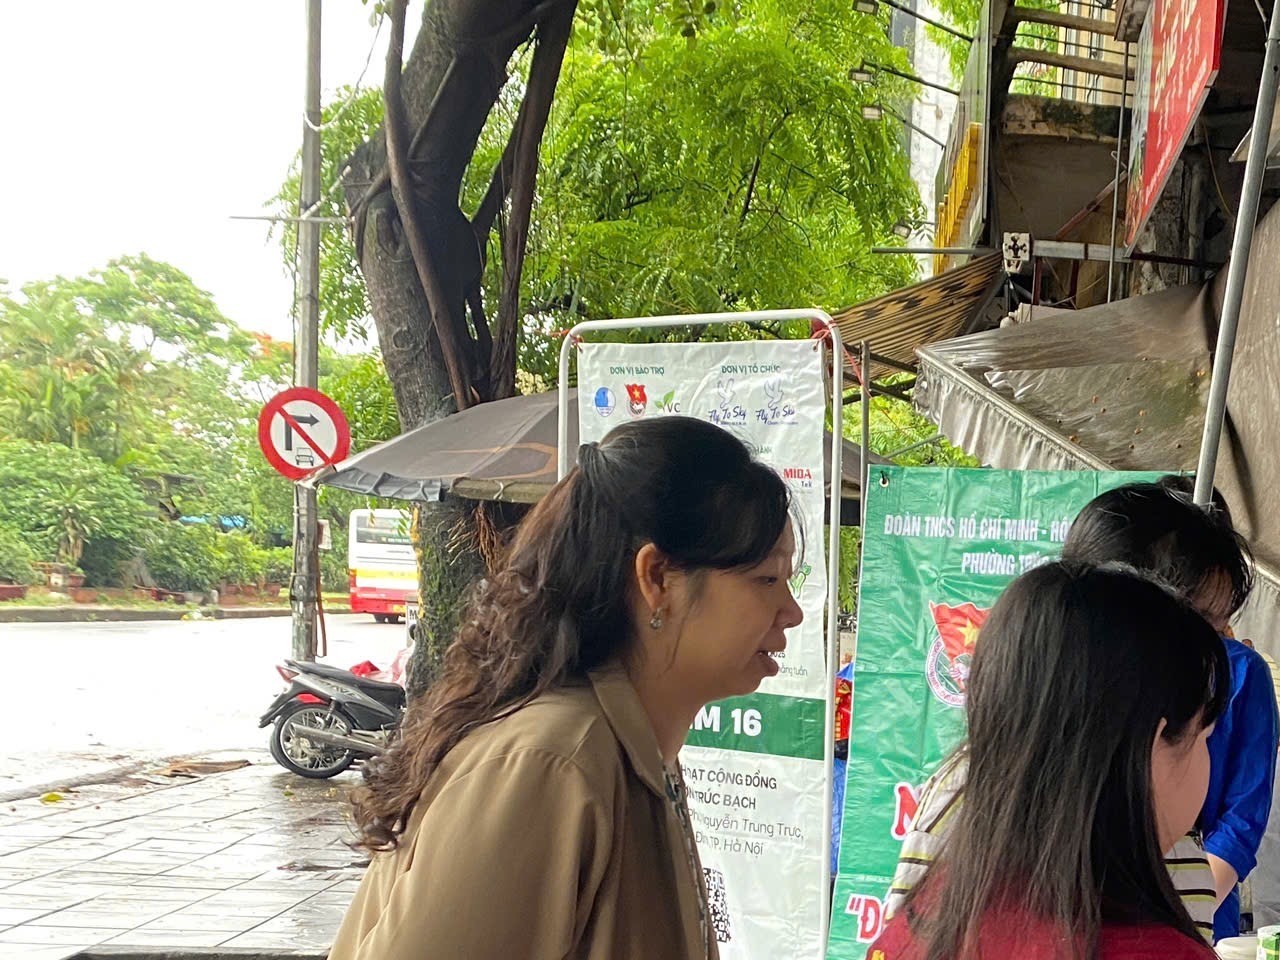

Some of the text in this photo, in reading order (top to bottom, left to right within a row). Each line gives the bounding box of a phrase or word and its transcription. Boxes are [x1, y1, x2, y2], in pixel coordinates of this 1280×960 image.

[783, 468, 812, 479] MIDA
[884, 512, 921, 537] ĐOÀN
[924, 516, 955, 538] TNCS
[979, 515, 1001, 540] CHÍ
[1004, 518, 1038, 542] MINH
[961, 548, 1016, 575] PHƯỜNG
[731, 708, 762, 737] 16
[707, 767, 743, 787] CỘNG
[745, 769, 777, 790] ĐỒNG
[694, 787, 721, 805] TRÚC
[723, 794, 757, 811] BẠCH
[742, 818, 774, 837] Trung
[724, 839, 742, 852] Hà
[744, 841, 764, 858] Nội
